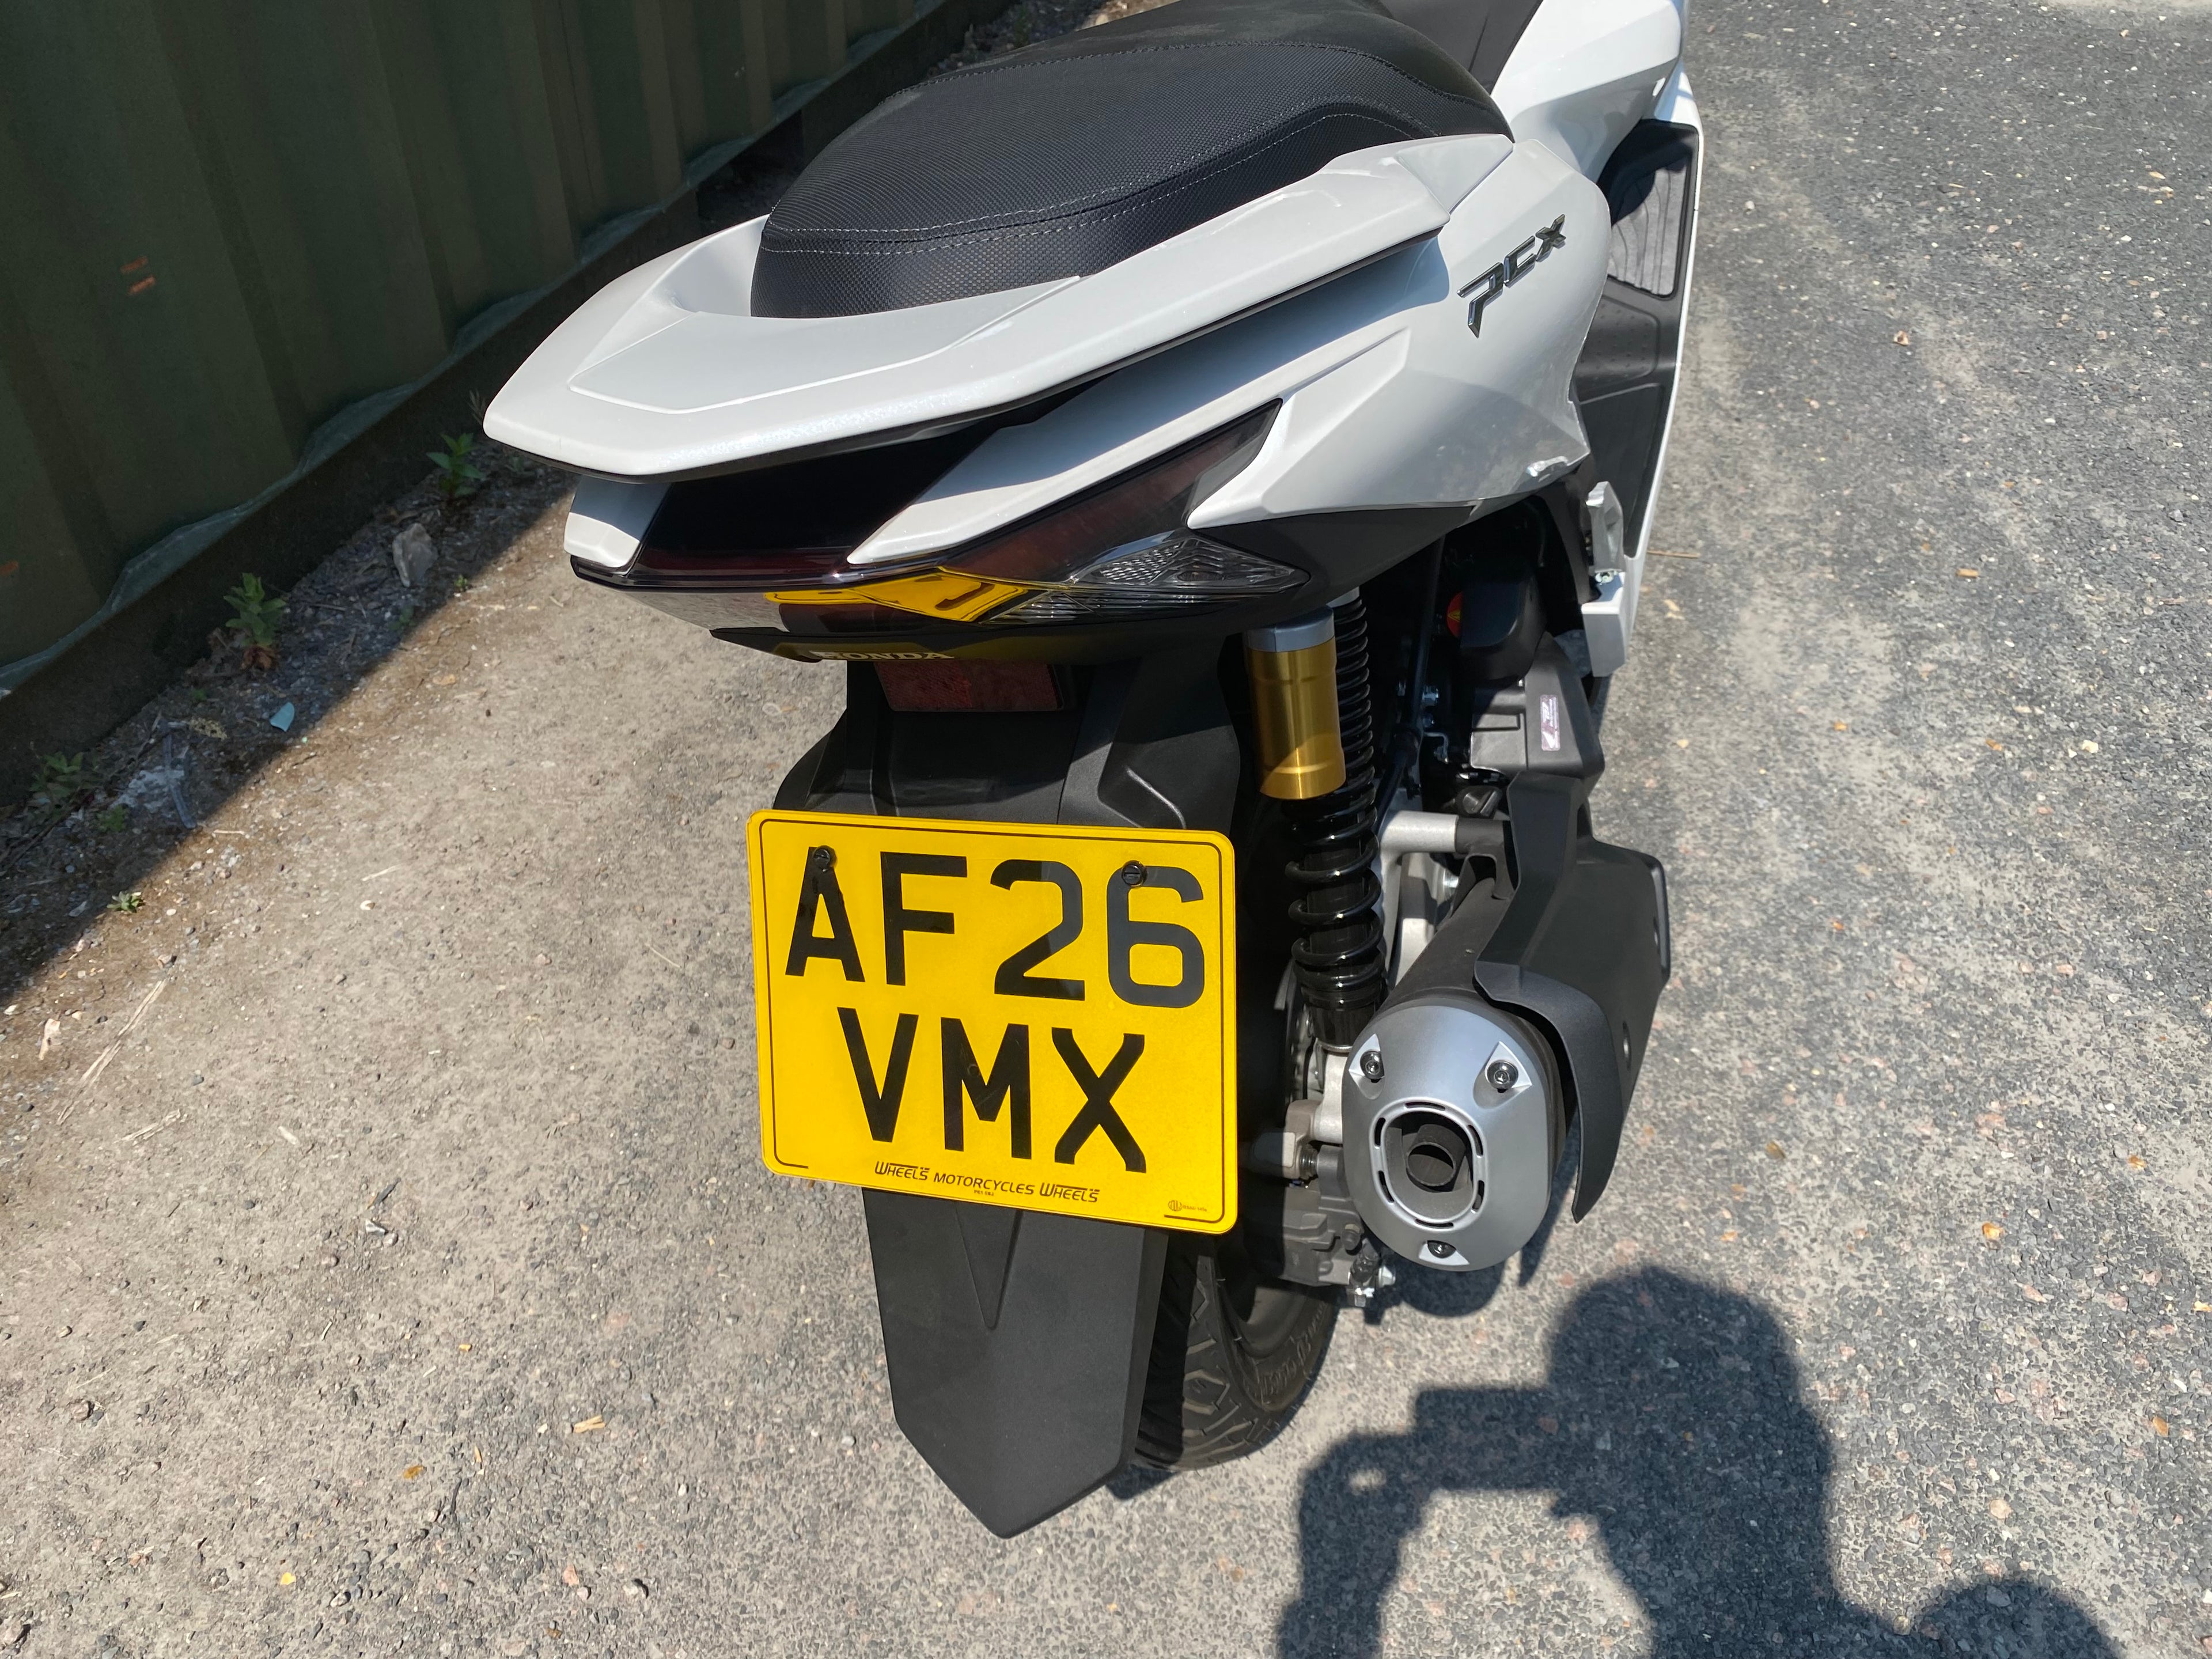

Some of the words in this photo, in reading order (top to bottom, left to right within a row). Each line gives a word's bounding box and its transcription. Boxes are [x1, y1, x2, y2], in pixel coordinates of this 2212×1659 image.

[1457, 214, 1566, 339] PCX
[785, 846, 1205, 1008] AF26
[837, 1006, 1146, 1173] VMX
[933, 1172, 1035, 1195] MOTORCYCLES
